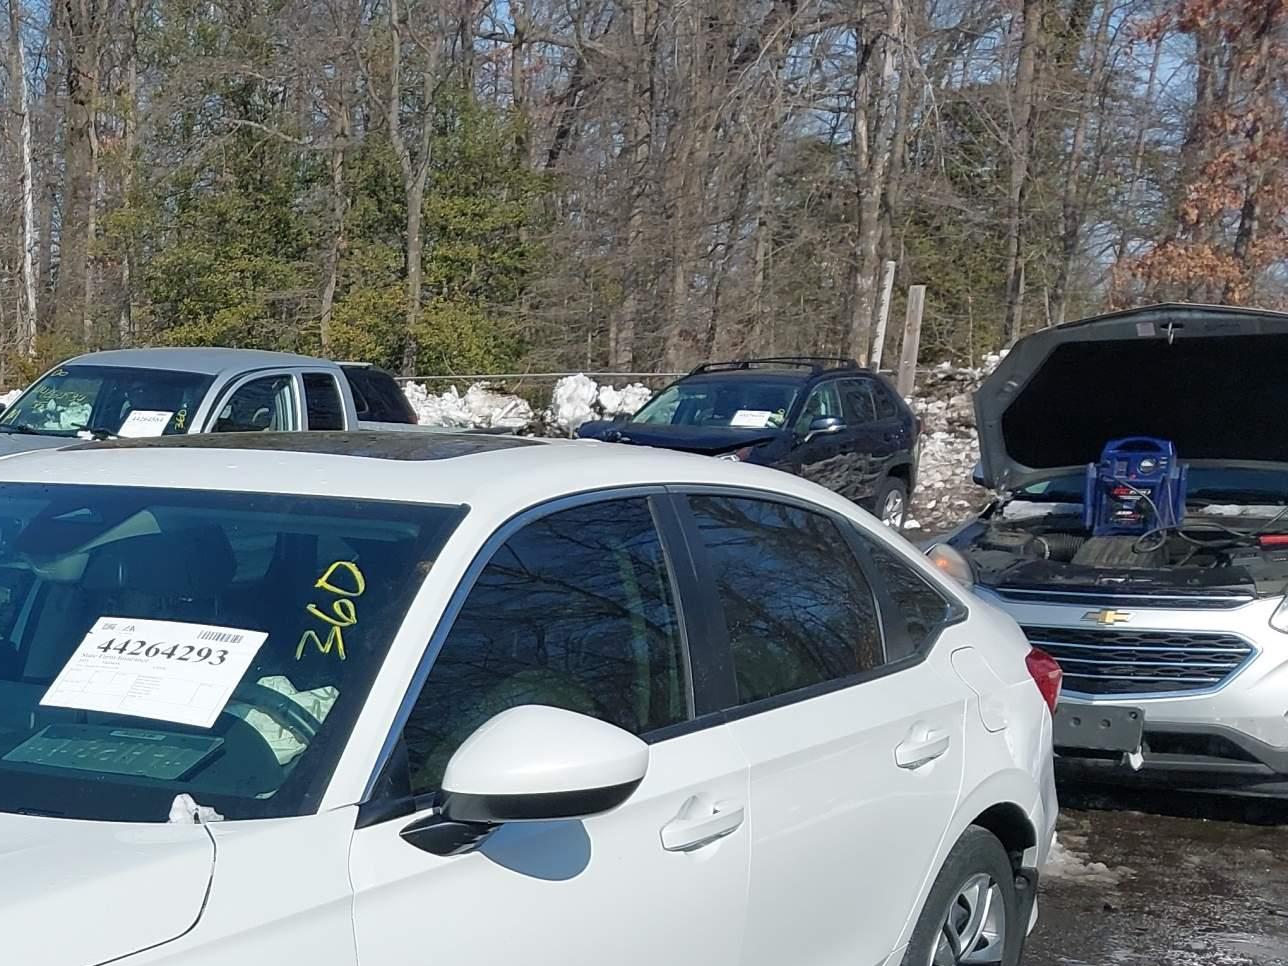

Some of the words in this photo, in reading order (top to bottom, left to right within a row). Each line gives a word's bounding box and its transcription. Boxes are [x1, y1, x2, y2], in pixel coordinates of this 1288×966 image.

[174, 409, 188, 430] 360
[295, 560, 366, 661] 360
[97, 637, 229, 666] 44264293
